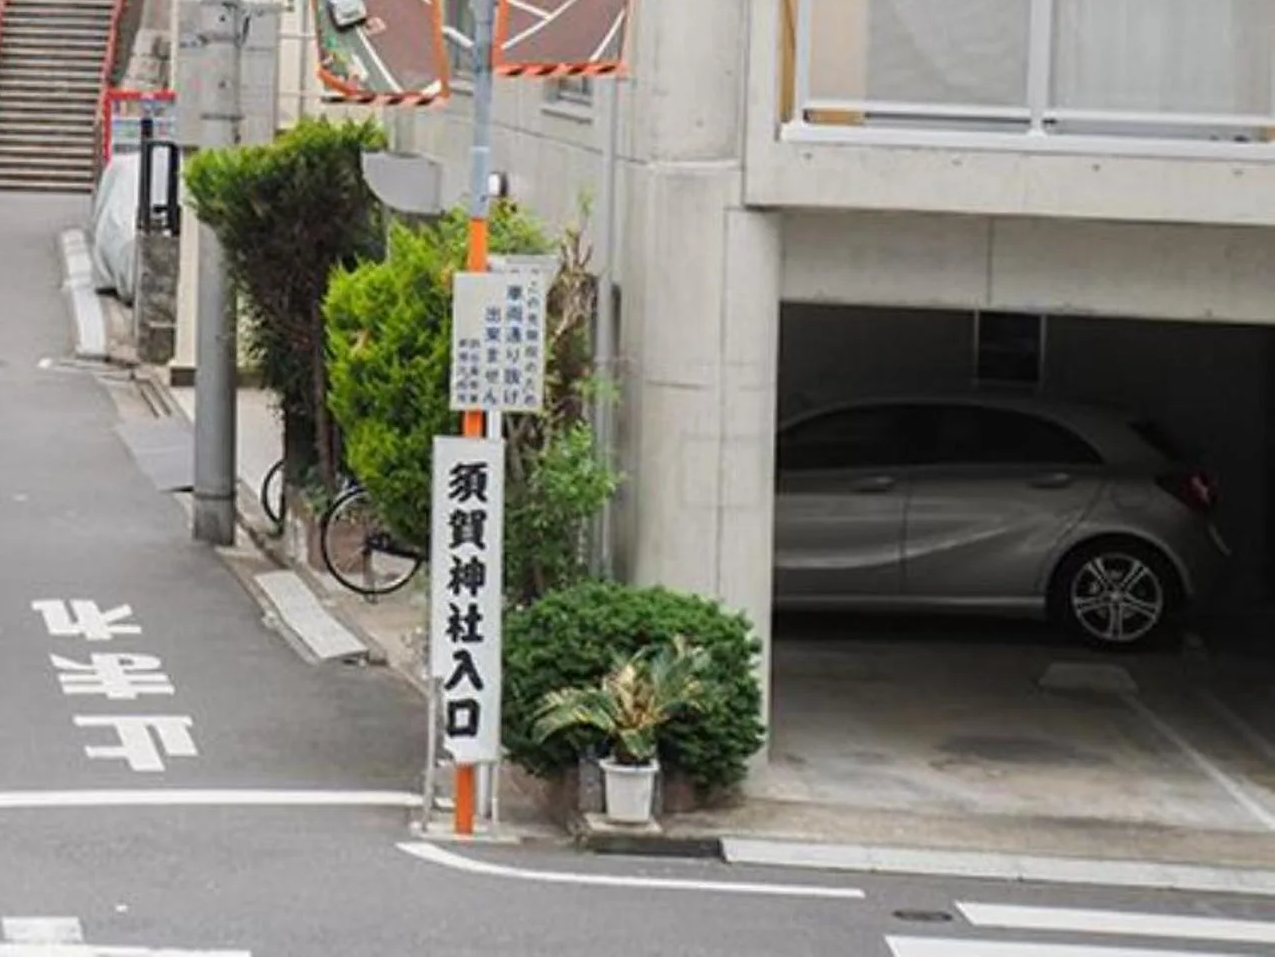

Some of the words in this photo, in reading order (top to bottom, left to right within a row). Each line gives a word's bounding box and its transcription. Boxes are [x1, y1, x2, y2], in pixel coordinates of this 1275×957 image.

[30, 598, 200, 773] 止まれ
[443, 461, 489, 739] 須賀神社入口
